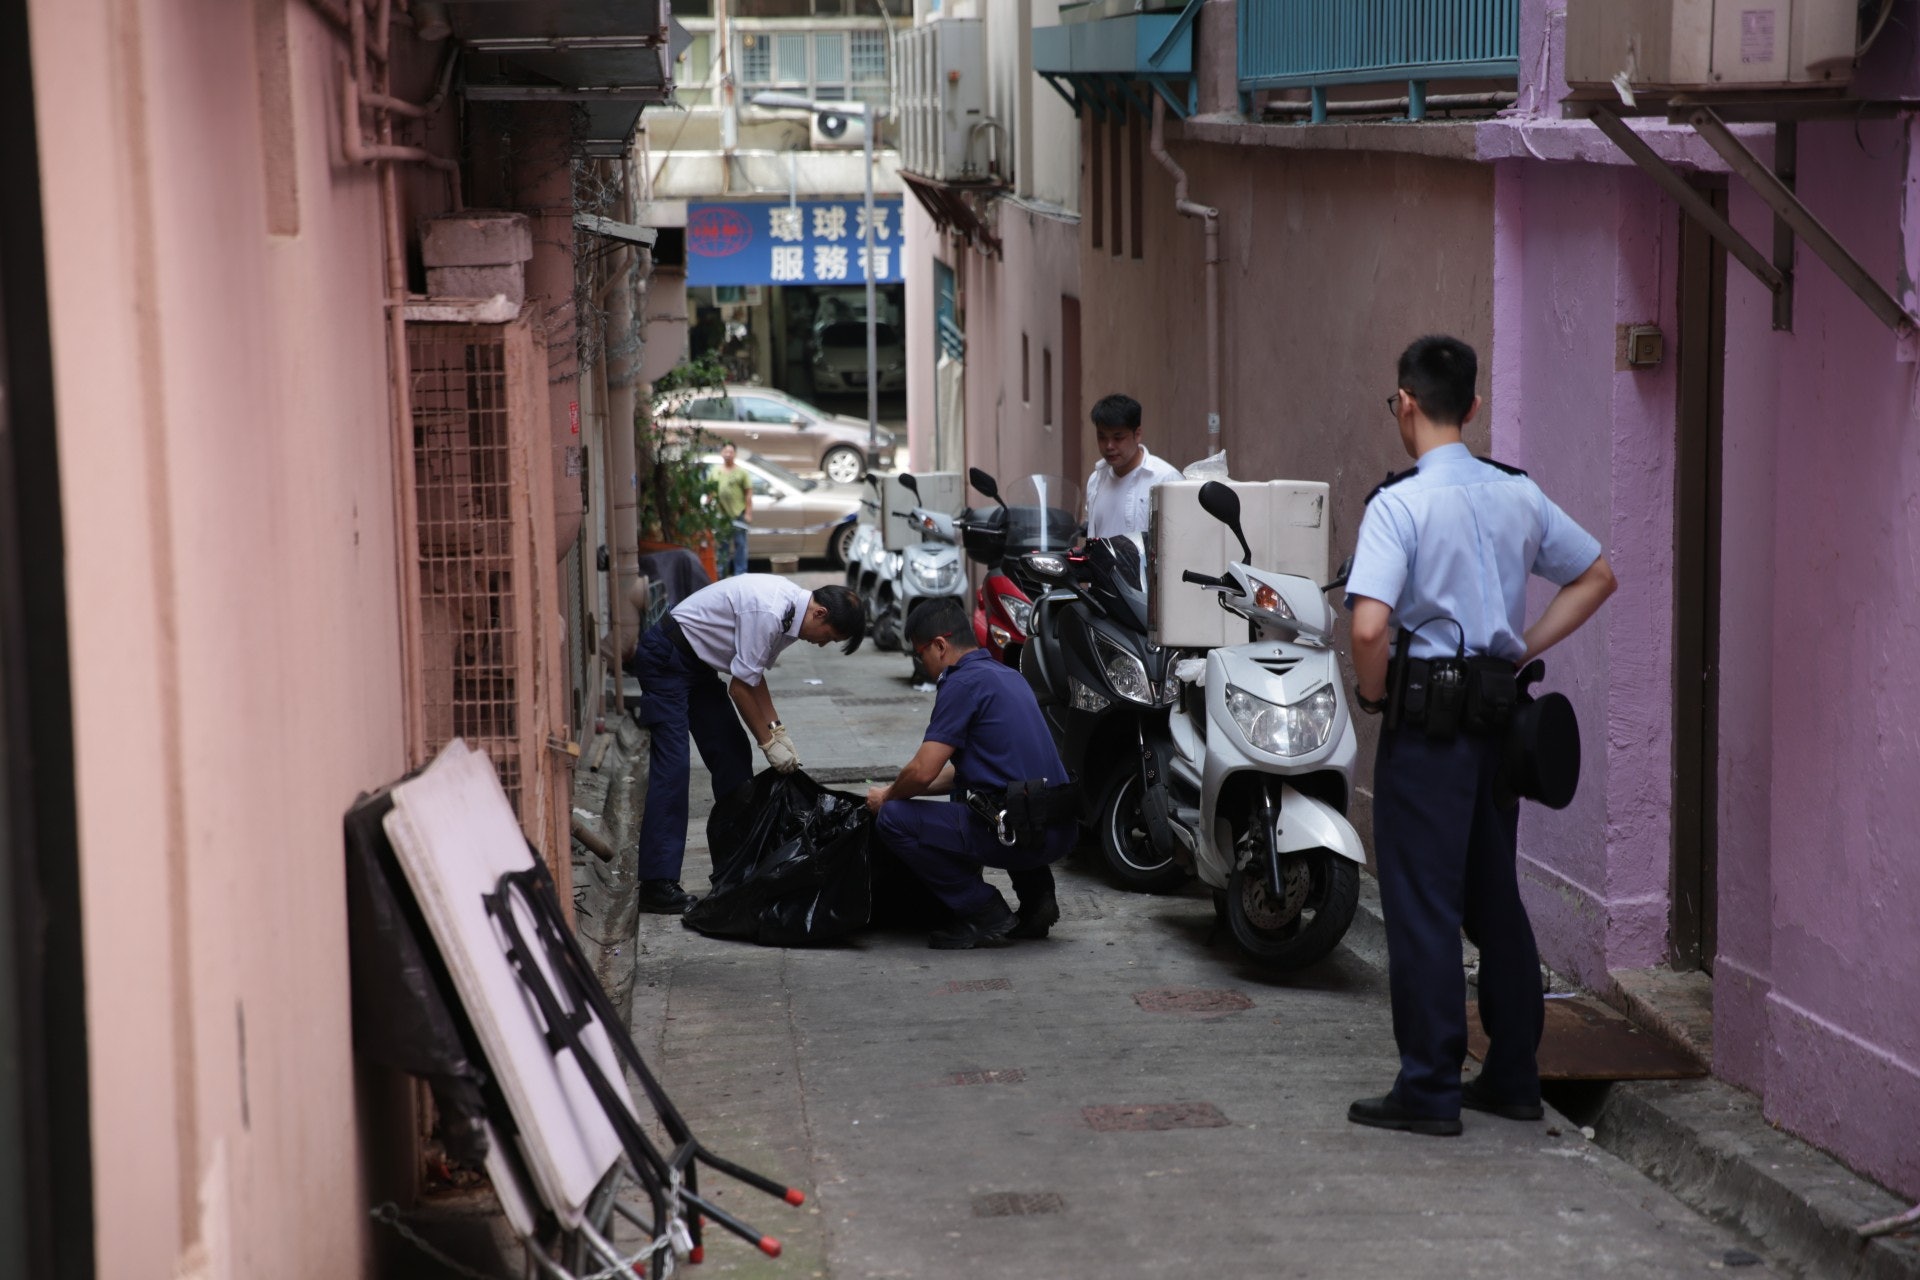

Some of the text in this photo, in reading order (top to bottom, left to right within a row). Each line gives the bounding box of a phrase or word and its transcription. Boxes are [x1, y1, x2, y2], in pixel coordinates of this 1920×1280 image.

[769, 205, 904, 241] 環球汽
[771, 245, 904, 280] 服務有
